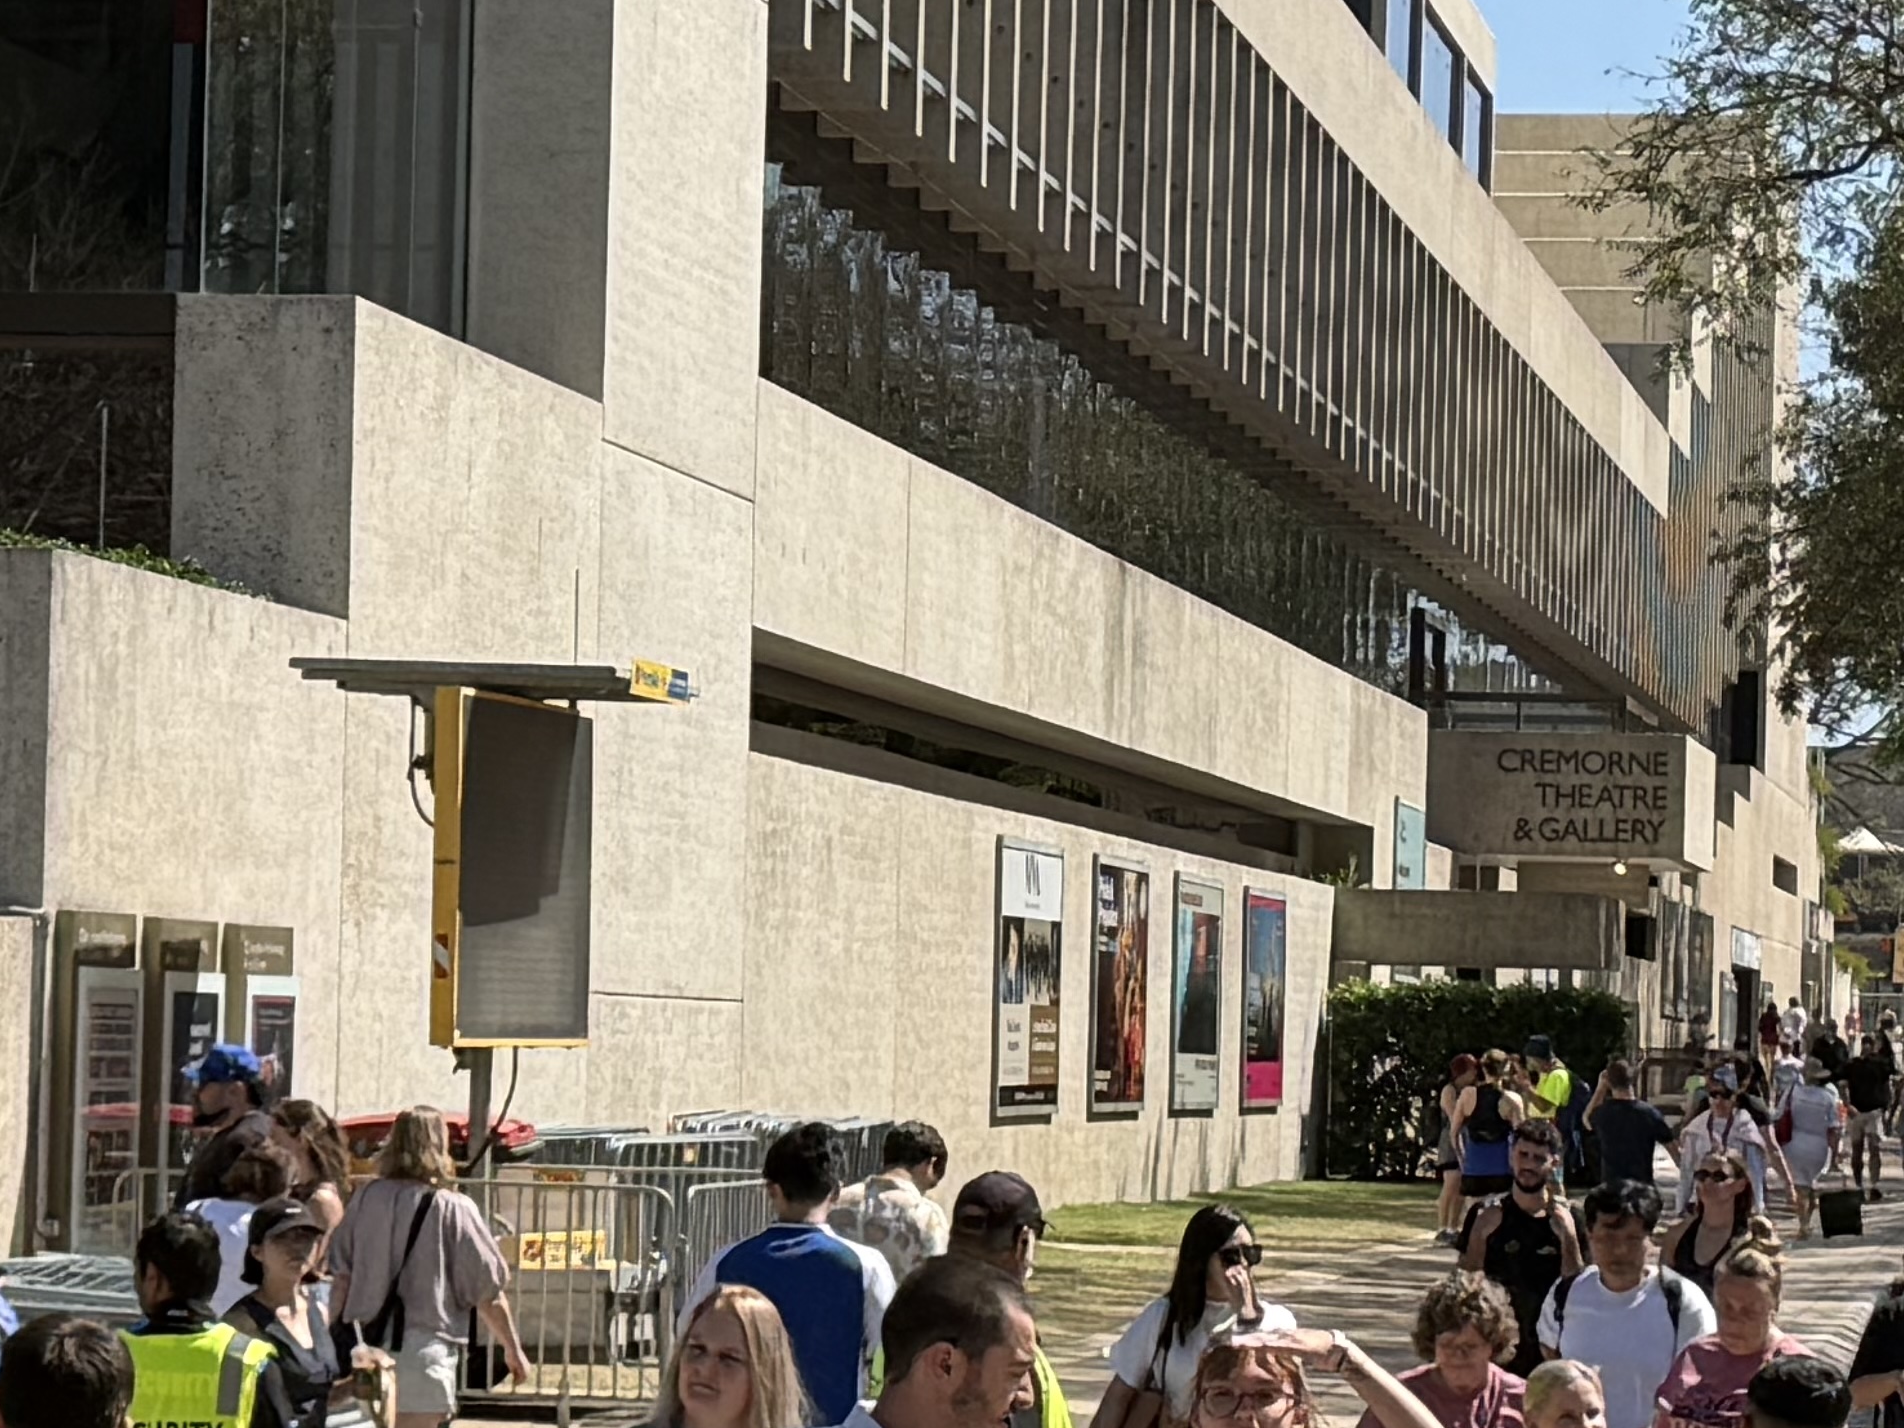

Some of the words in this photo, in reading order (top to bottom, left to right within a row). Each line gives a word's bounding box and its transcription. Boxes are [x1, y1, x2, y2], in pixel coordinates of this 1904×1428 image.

[1497, 748, 1669, 777] CREMORNE
[1534, 782, 1668, 810] THEATRE
[1513, 817, 1533, 842] &
[1538, 817, 1666, 844] GALLERY
